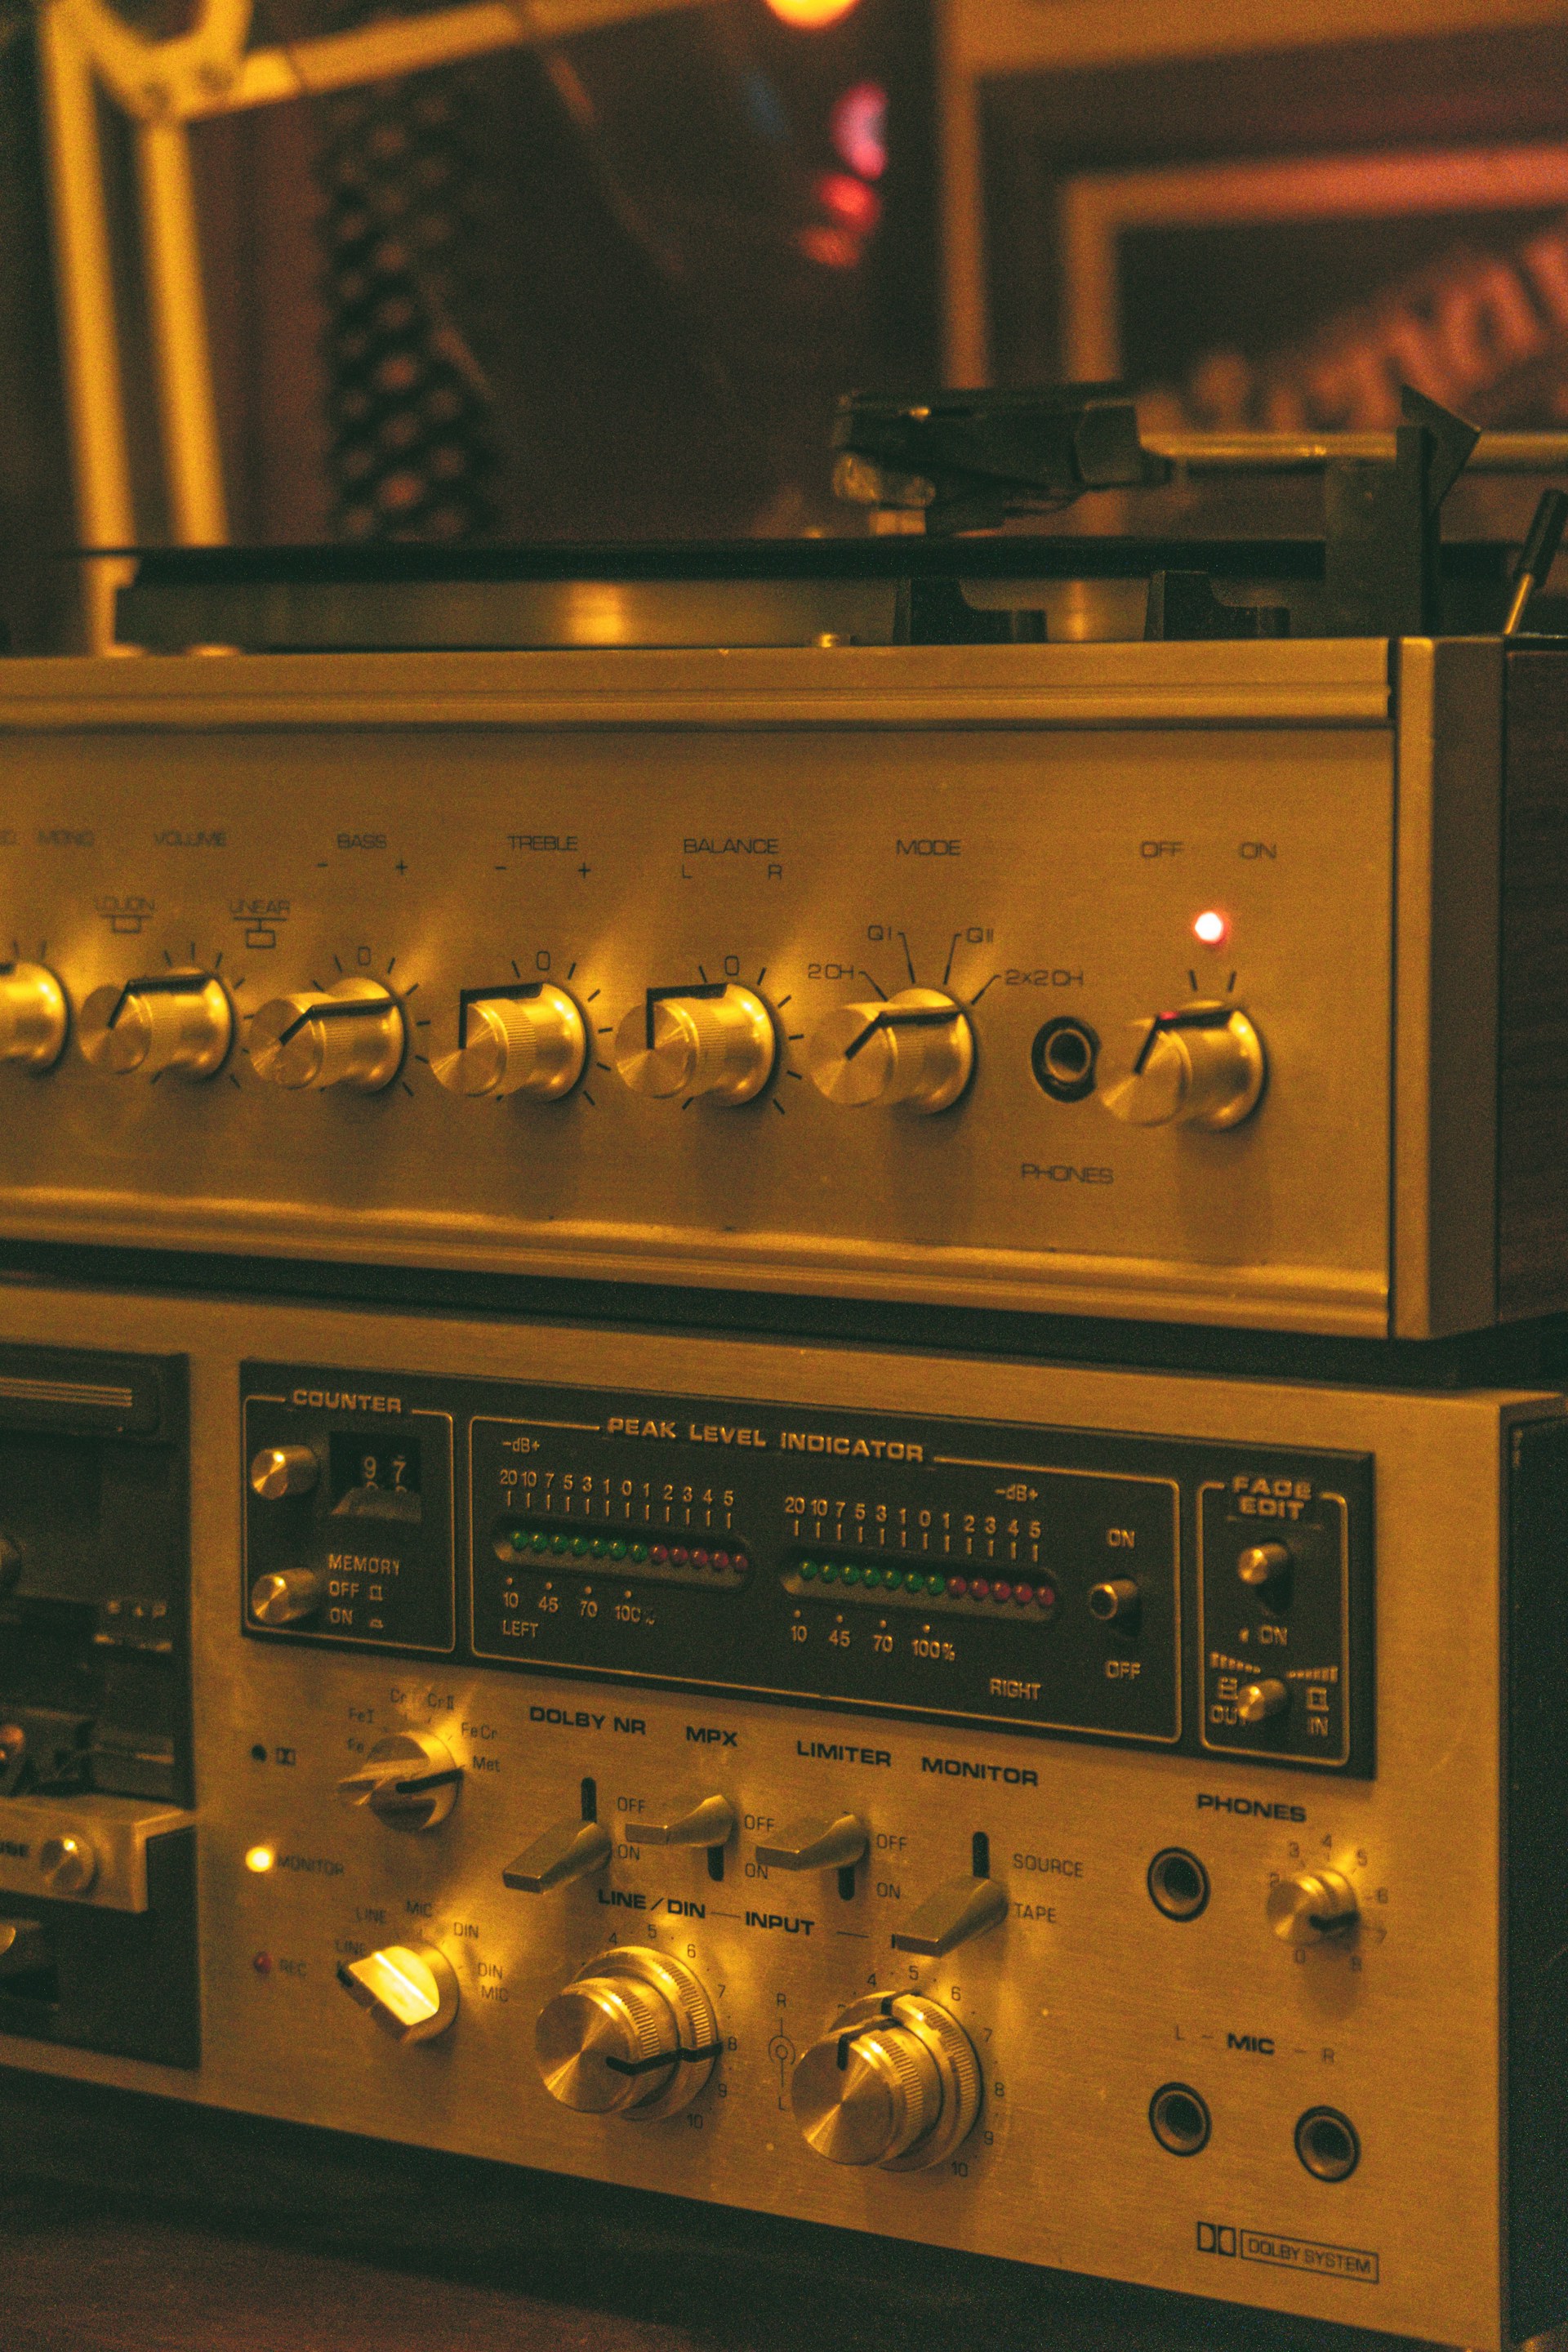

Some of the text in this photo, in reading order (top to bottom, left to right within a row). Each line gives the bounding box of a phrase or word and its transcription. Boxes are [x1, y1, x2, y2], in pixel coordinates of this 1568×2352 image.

[154, 830, 227, 847] VOLUME
[336, 833, 387, 849] BASS
[507, 835, 578, 851] TREBLE
[684, 838, 779, 854] BALANCE
[896, 840, 961, 856] MODE
[1141, 841, 1183, 859] OFF
[1239, 843, 1276, 859] ON
[681, 864, 782, 880] L R
[1021, 1163, 1114, 1184] PHONES
[292, 1389, 403, 1414] COUNTER
[607, 1417, 924, 1463] PEAK LEVEL INDICATOR
[500, 1469, 734, 1507] 20 10 7 5 3 1 0 1 2 3 4 5
[785, 1496, 1041, 1539] 20 10 7 5 3 1 0 1 2 3 4 5
[1239, 1496, 1305, 1521] EDIT
[1107, 1528, 1135, 1548] ON
[328, 1554, 400, 1575] MEMORY
[329, 1580, 359, 1599] OFF
[503, 1592, 519, 1609] 10
[580, 1601, 598, 1618] 70
[330, 1607, 353, 1624] ON
[501, 1619, 538, 1637] LEFT
[1258, 1624, 1288, 1646] ON
[791, 1625, 956, 1662] 10 45 70 100%
[1106, 1660, 1142, 1679] OFF
[989, 1677, 1042, 1700] RIGHT
[530, 1706, 646, 1735] DOLBY NR
[1310, 1717, 1328, 1736] IN
[686, 1726, 738, 1747] MPX
[797, 1740, 891, 1767] LIMITER
[472, 1756, 501, 1772] Met
[921, 1757, 1039, 1786] MONITOR
[617, 1797, 646, 1814] OFF
[1196, 1793, 1307, 1823] PHONES
[744, 1815, 775, 1833] OFF
[876, 1833, 906, 1851] OFF
[617, 1844, 640, 1860] ON
[277, 1855, 345, 1876] MONITOR
[745, 1863, 769, 1880] ON
[1013, 1853, 1084, 1878] SOURCE
[876, 1882, 902, 1899] ON
[1013, 1903, 1057, 1922] TAPE
[453, 1922, 479, 1938] DIN
[745, 1911, 814, 1936] INPUT
[688, 1944, 697, 1958] 6
[477, 1962, 503, 1979] DIN
[908, 1965, 919, 1980] 5
[481, 1985, 509, 2002] MIC
[951, 1985, 961, 2001] 6
[1227, 2033, 1275, 2056] MIC
[1248, 2238, 1303, 2261] DOLBY
[1304, 2249, 1371, 2274] SYSTEM
